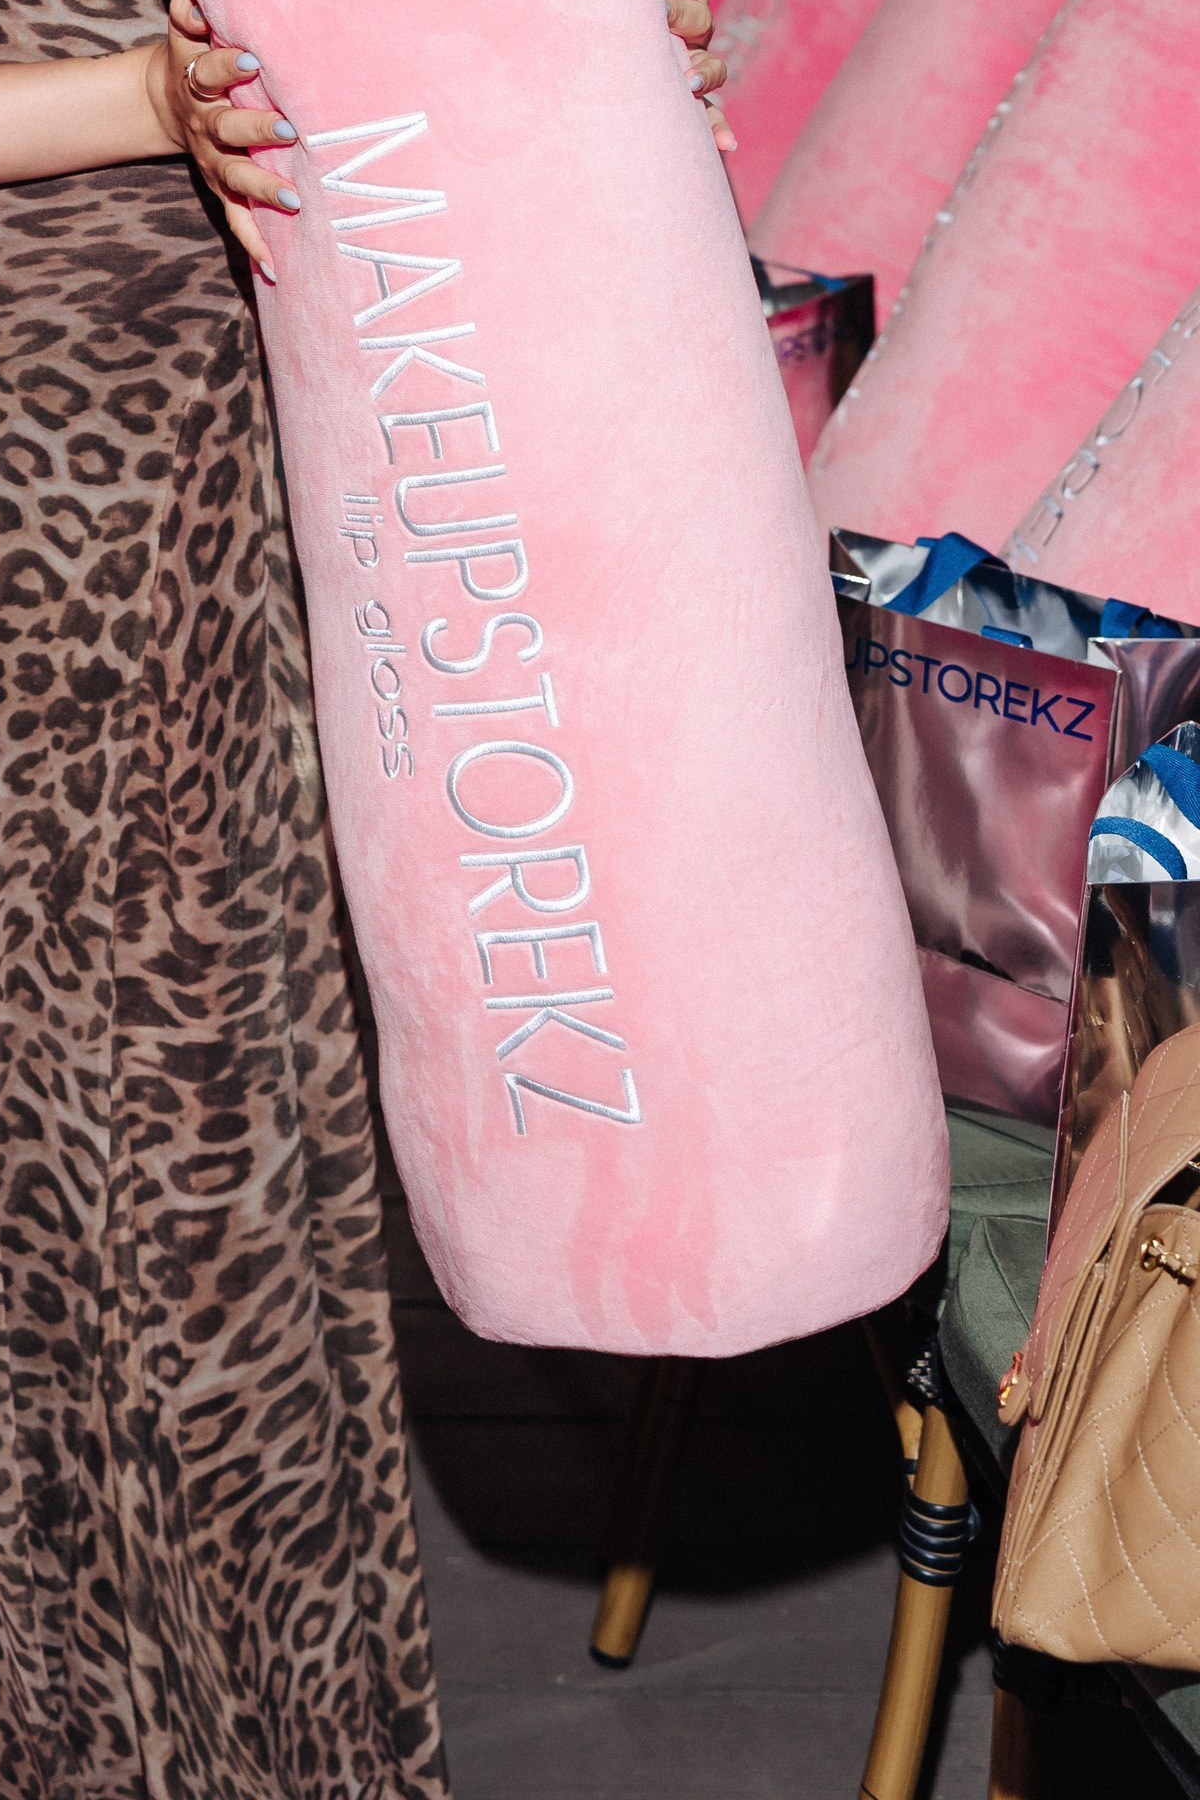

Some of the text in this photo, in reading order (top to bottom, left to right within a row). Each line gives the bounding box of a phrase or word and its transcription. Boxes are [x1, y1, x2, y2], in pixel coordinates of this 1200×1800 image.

[307, 111, 644, 1135] MAKEUPSTOREKZ
[339, 494, 414, 778] lip gloss
